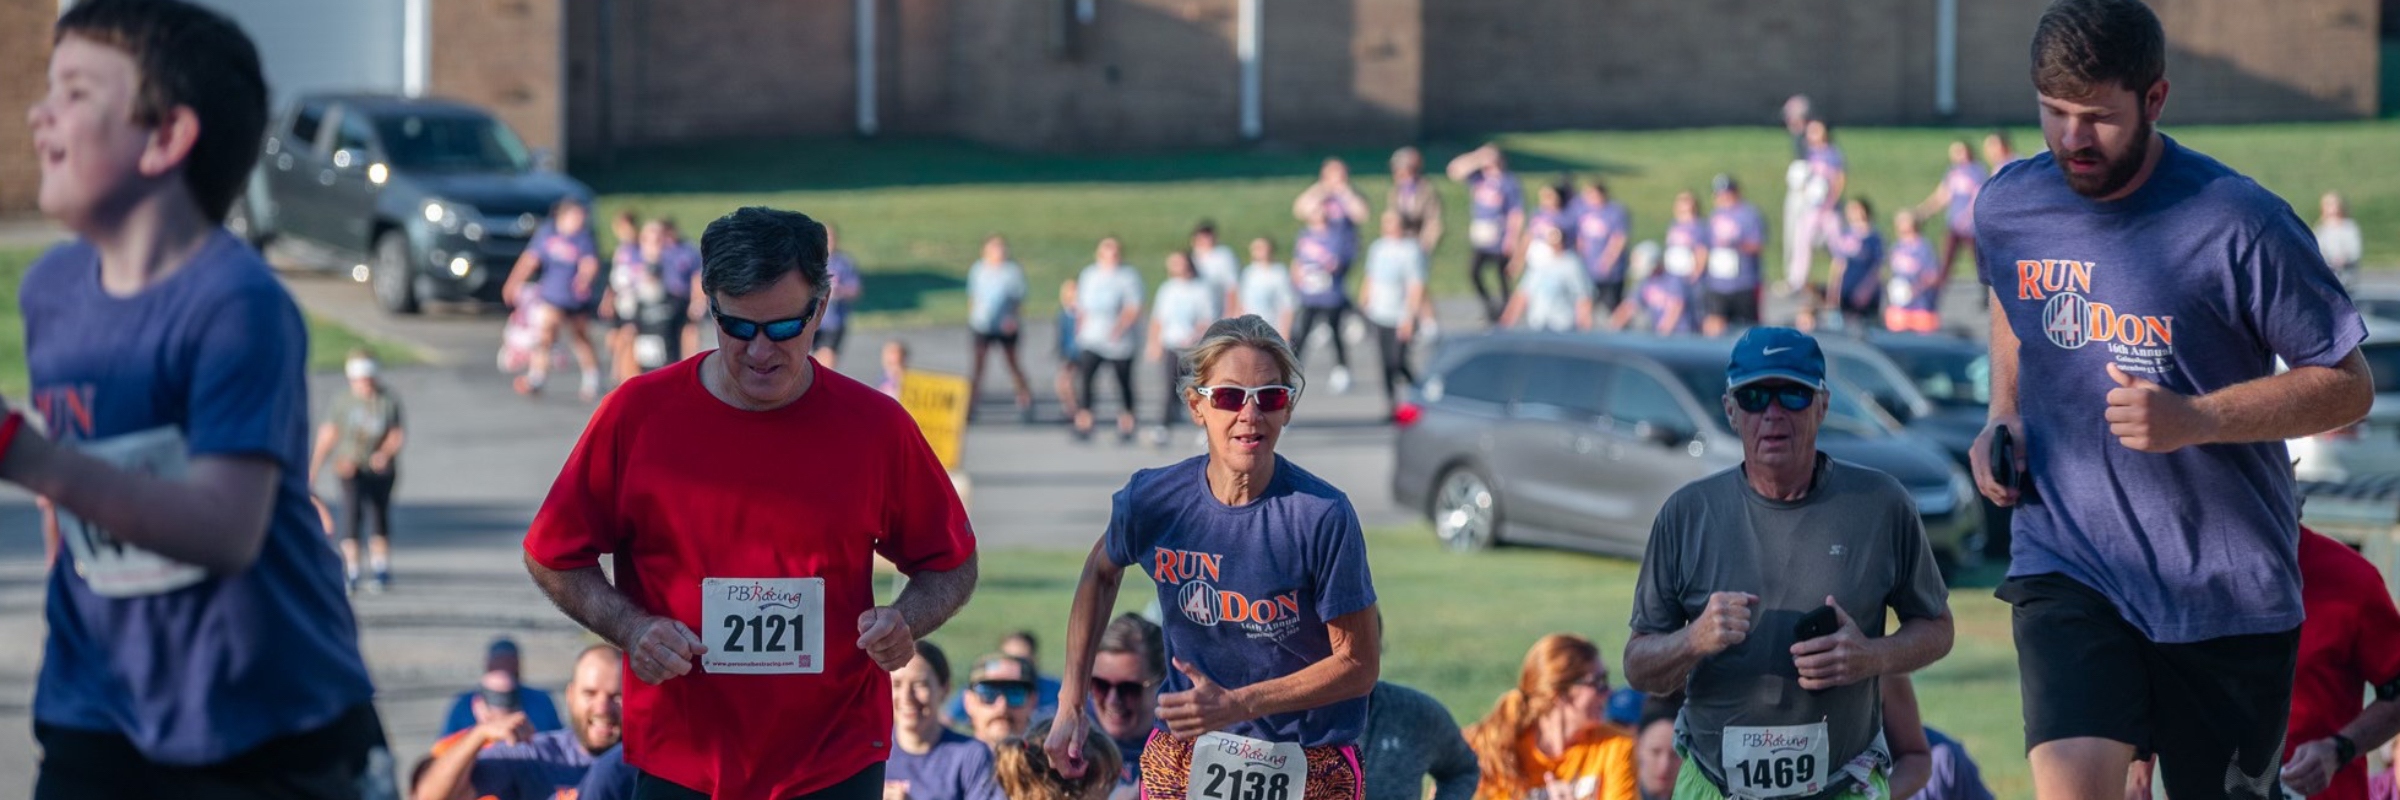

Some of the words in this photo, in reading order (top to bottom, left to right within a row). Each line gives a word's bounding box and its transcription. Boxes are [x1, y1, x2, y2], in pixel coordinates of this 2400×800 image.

[2016, 259, 2095, 300] RUN
[2048, 296, 2081, 341] 4
[2089, 302, 2173, 347] DON
[2107, 342, 2129, 355] 16th
[2131, 345, 2173, 357] Annual
[2116, 364, 2146, 373] eptember
[1154, 546, 1223, 585] RUN
[1184, 585, 1211, 622] 4
[1217, 590, 1300, 624] DON
[723, 614, 804, 652] 2121
[1240, 622, 1262, 632] 16th
[1264, 615, 1301, 632] Annual
[712, 659, 795, 668] www.personalbestracing.com
[1203, 763, 1290, 800] 2138
[1736, 754, 1815, 789] 1469
